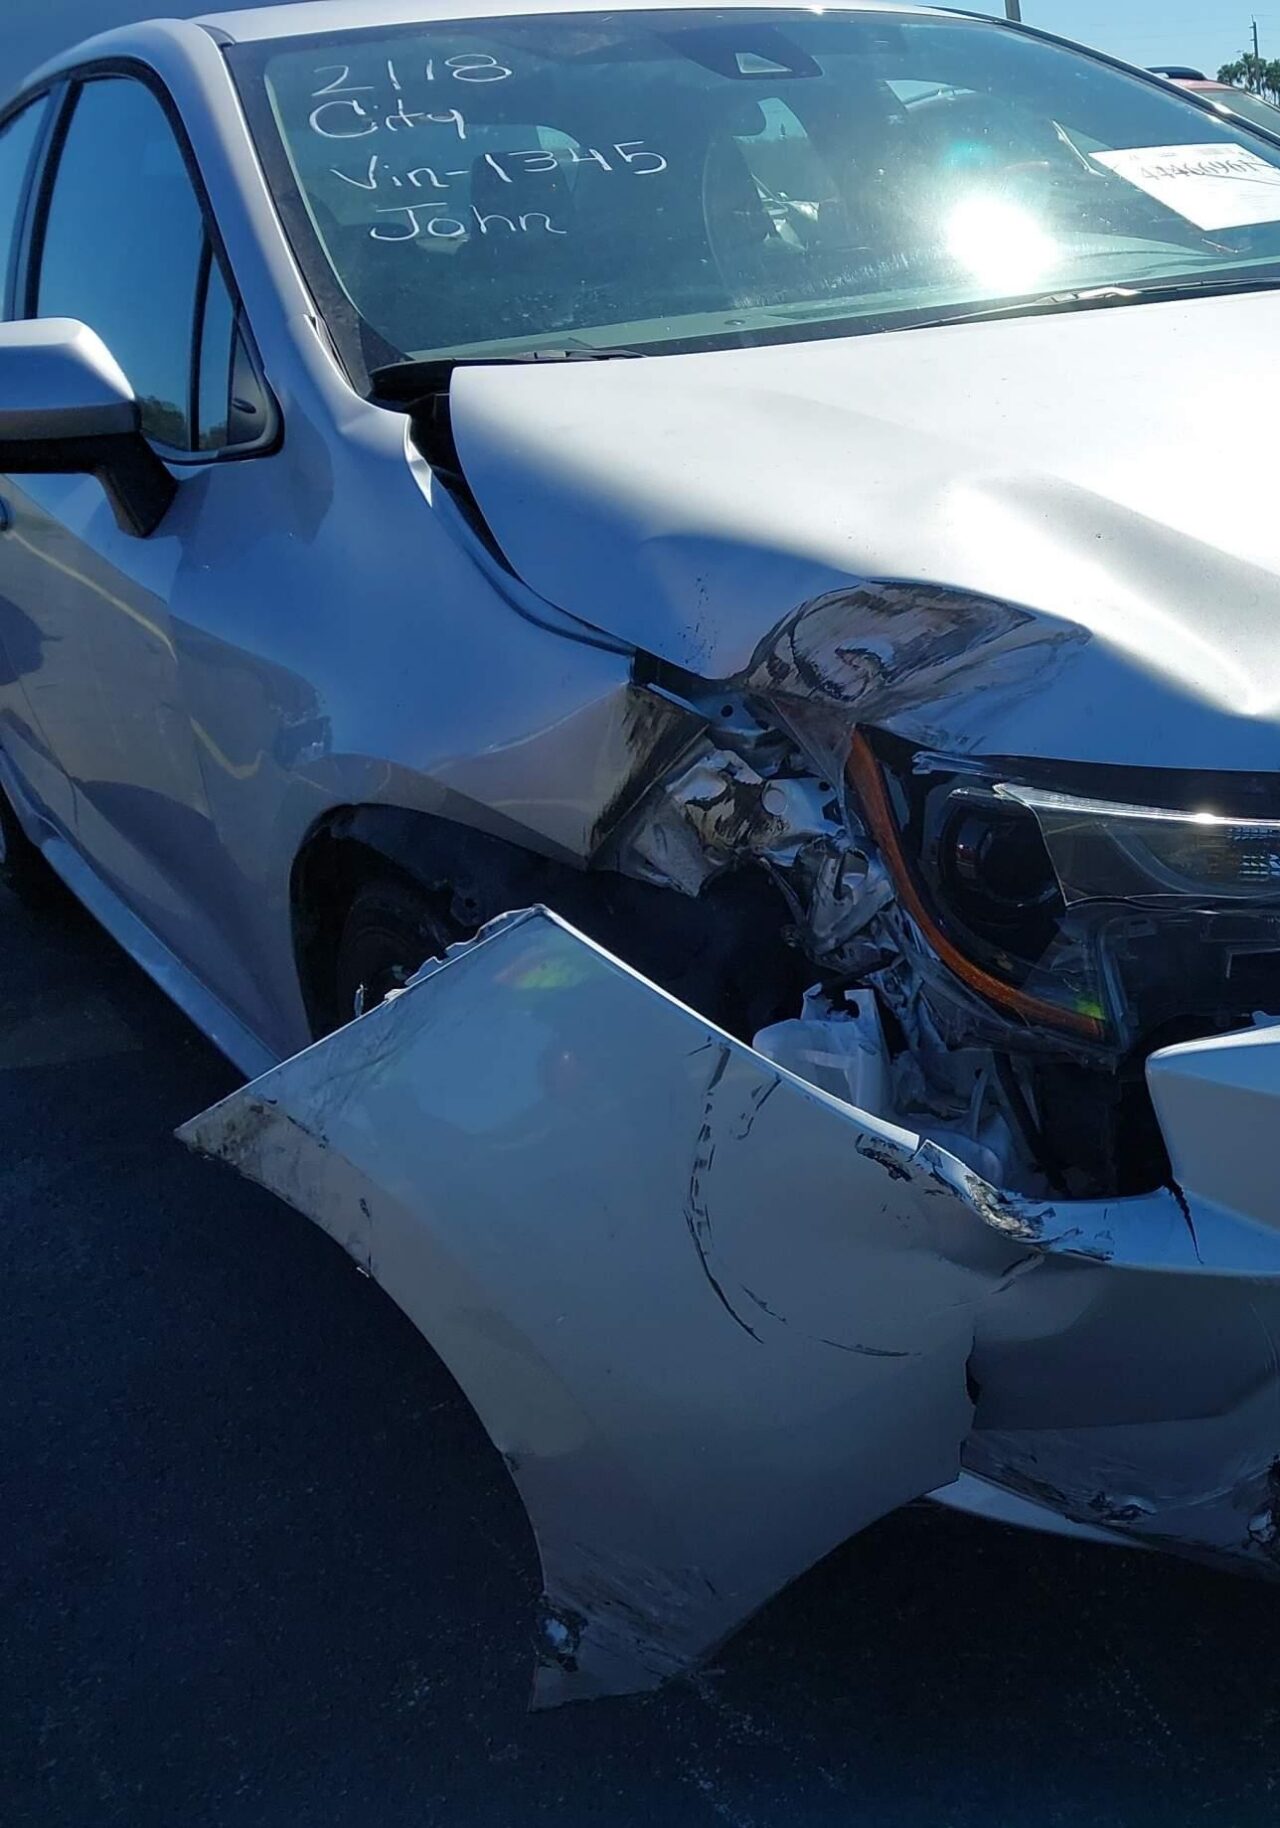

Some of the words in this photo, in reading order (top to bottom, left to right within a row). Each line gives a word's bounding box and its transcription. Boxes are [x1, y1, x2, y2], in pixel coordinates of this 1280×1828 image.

[311, 54, 512, 96] 2118
[309, 99, 467, 139] City
[369, 202, 568, 242] John
